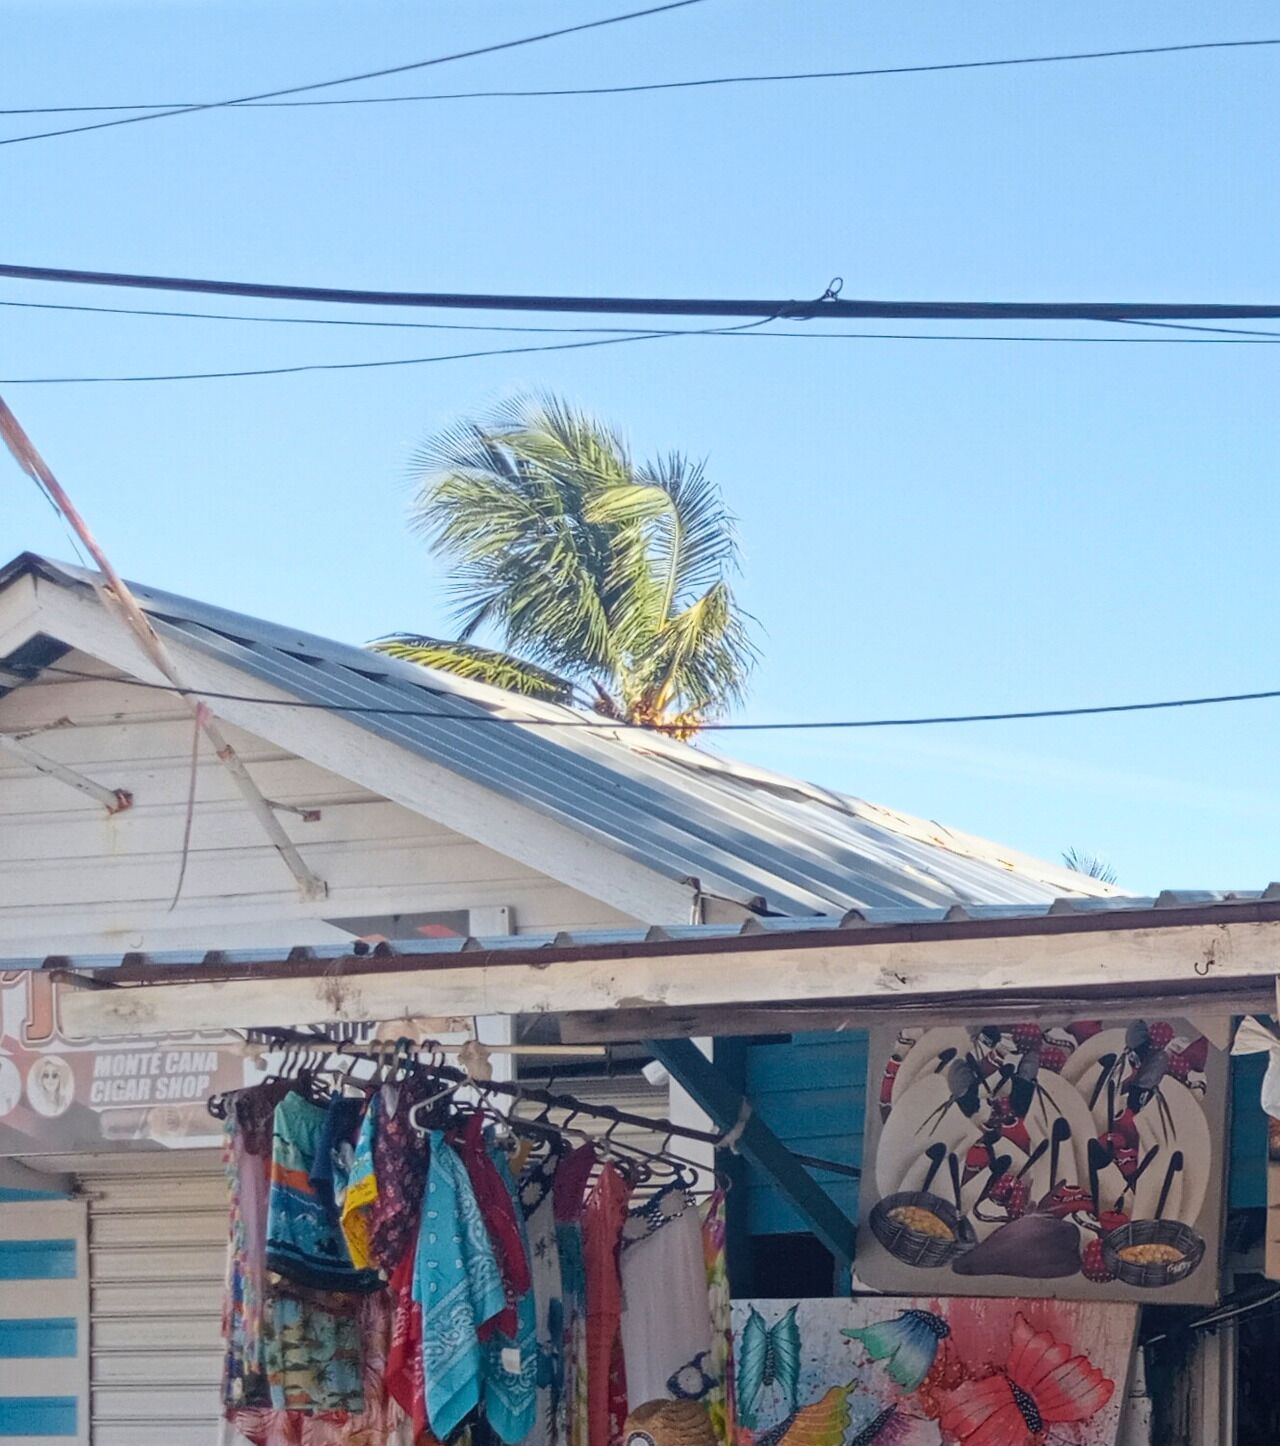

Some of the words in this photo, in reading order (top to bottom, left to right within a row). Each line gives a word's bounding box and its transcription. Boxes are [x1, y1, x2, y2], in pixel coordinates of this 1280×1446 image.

[94, 1052, 162, 1078] MONTE
[164, 1051, 218, 1075] CANA
[90, 1077, 154, 1101] CIGAR
[155, 1075, 210, 1099] SHOP
